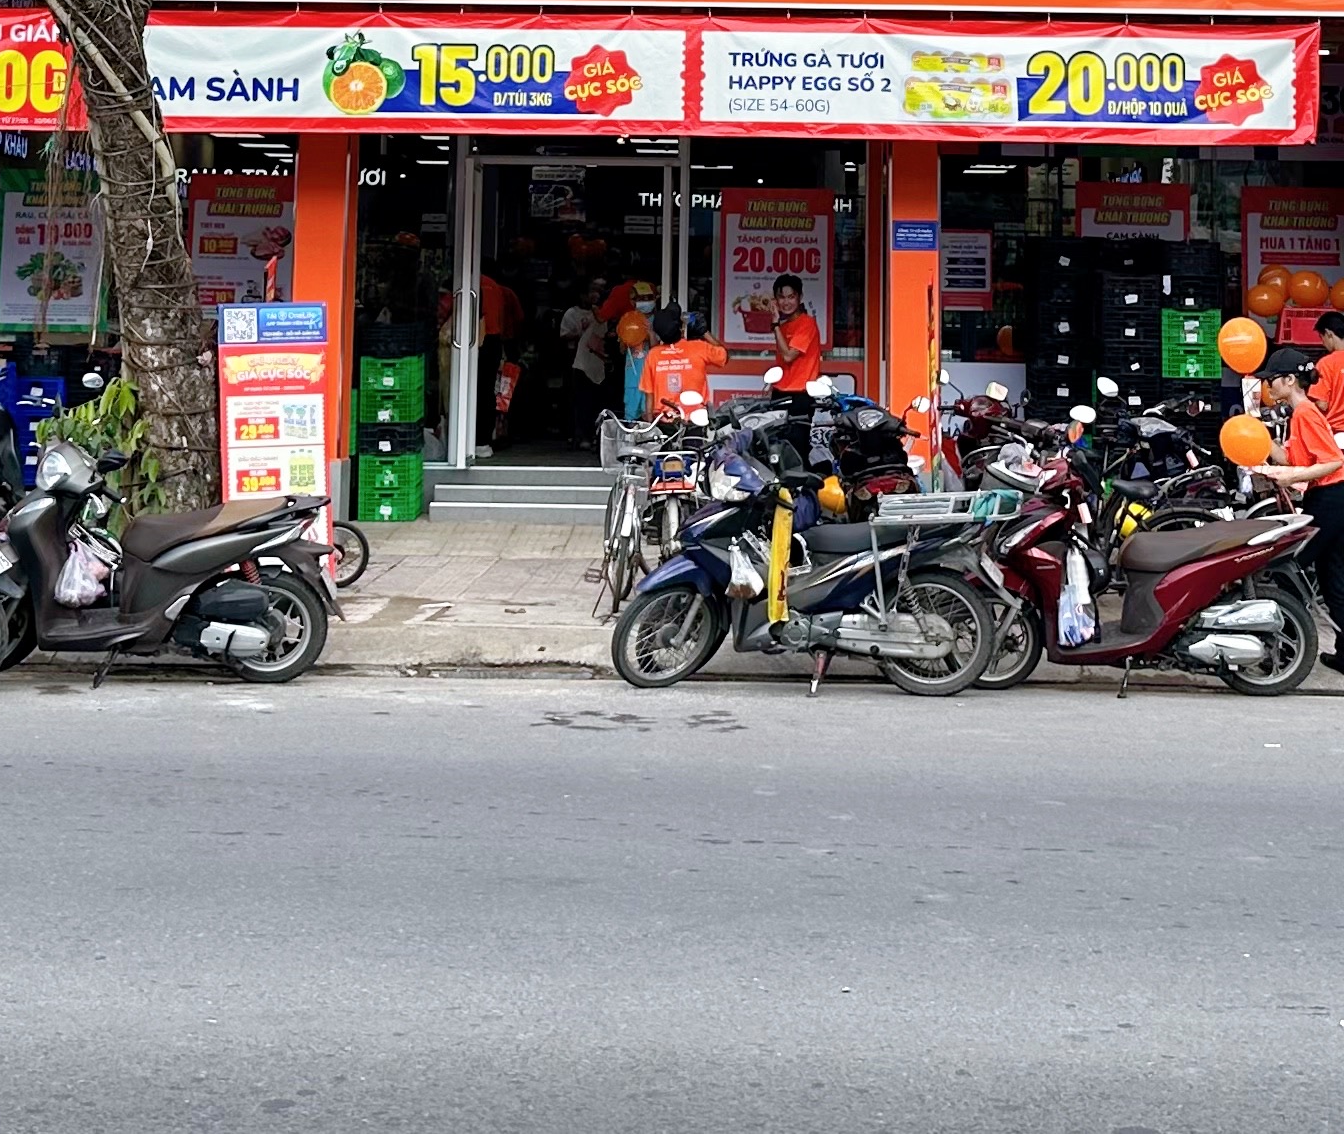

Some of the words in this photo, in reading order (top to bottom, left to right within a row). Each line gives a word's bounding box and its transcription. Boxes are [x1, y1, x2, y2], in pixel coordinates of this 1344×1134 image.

[582, 56, 616, 78] GIÁ
[728, 47, 798, 68] TRỨNG
[803, 47, 832, 68] GÀ
[838, 51, 885, 69] TƯƠI
[152, 76, 196, 101] AM
[205, 69, 300, 102] SÀNH
[563, 79, 603, 103] CỰC
[606, 73, 644, 94] SỐC
[728, 74, 797, 91] HAPPY
[802, 76, 842, 92] EGG
[847, 71, 876, 93] SỐ
[880, 77, 892, 93] 2
[1026, 50, 1186, 116] 20.000
[1212, 68, 1246, 88] GIÁ
[529, 92, 553, 107] 3KG
[728, 97, 766, 115] (SIZE
[769, 98, 831, 115] 54-60G)
[1148, 101, 1161, 116] 10
[1163, 98, 1189, 117] QUẢ
[1194, 91, 1233, 113] CỰC
[1236, 82, 1275, 107] SỐC
[1259, 236, 1287, 251] MUA
[1289, 237, 1296, 251] 1
[1334, 237, 1341, 252] 1
